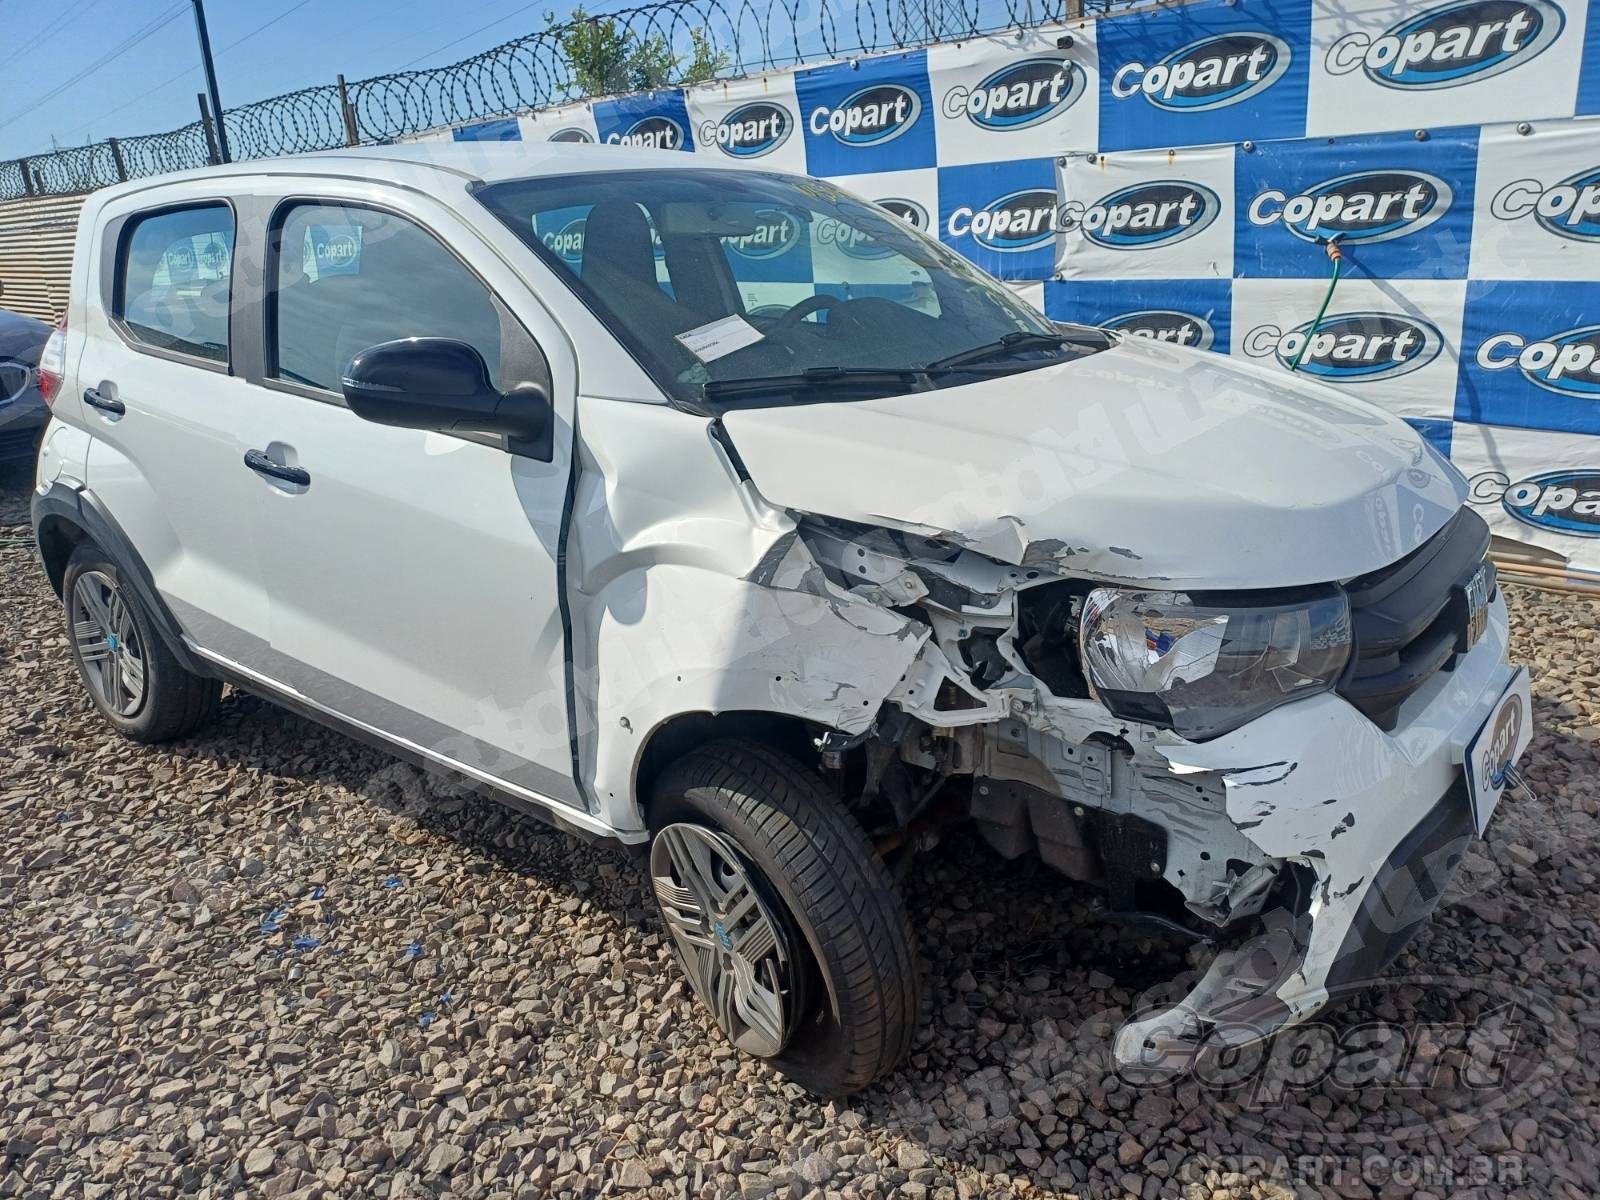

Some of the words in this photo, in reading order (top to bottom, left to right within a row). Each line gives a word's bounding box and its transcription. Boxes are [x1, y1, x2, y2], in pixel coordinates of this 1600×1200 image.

[1325, 8, 1534, 76] Copart
[942, 68, 1067, 119] Copart
[1111, 44, 1270, 99] Copart
[698, 112, 779, 149] Copart
[810, 94, 906, 136] Copart
[1054, 191, 1197, 237] Copart
[1248, 182, 1429, 231] Copart
[317, 241, 353, 262] Copart
[543, 232, 585, 255] Copa
[1243, 324, 1417, 362] Copart
[1474, 332, 1600, 381] Cop
[1482, 706, 1517, 792] Copart
